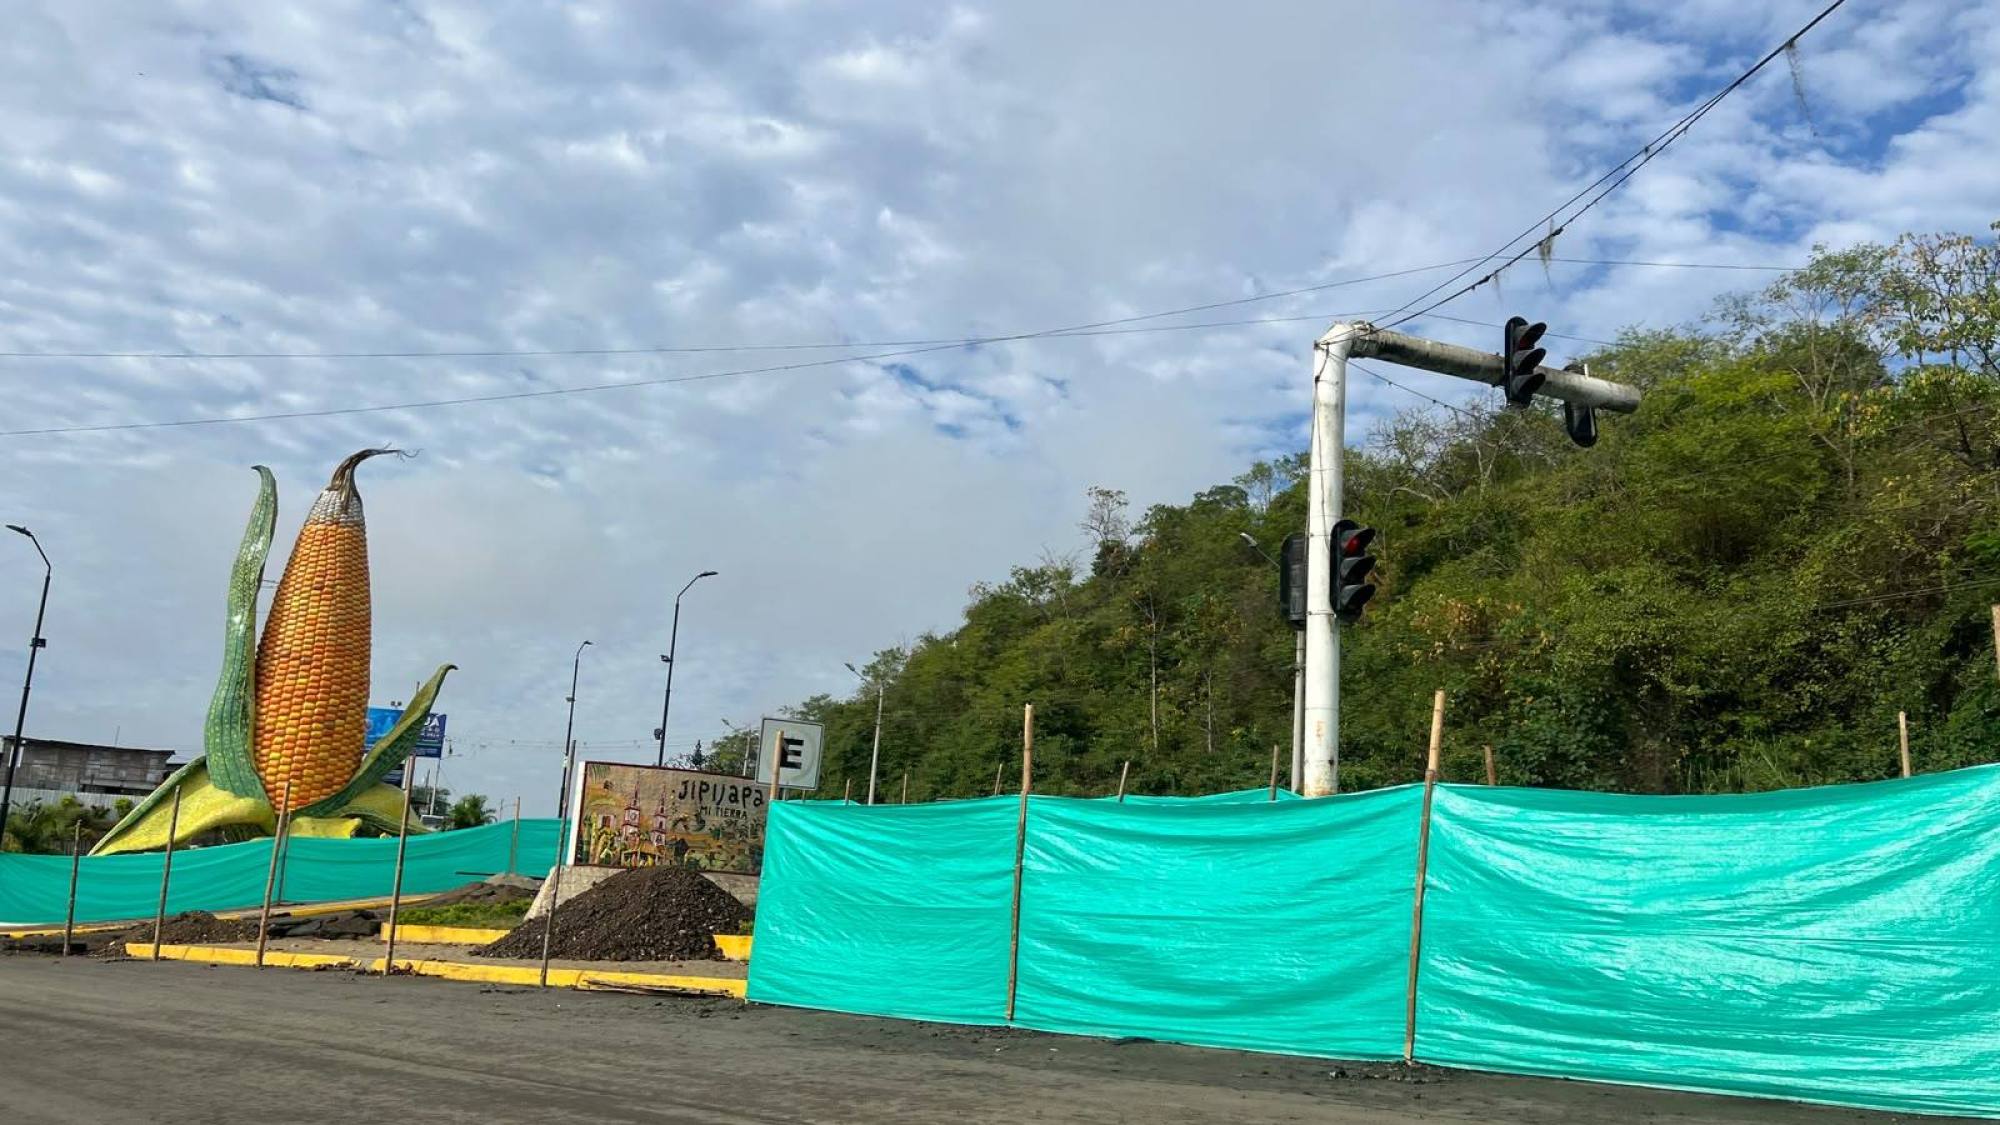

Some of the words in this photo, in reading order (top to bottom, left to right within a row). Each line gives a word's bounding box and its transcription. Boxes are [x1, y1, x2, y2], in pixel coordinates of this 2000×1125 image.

[779, 738, 804, 770] E
[701, 807, 711, 816] MI
[716, 807, 748, 820] TIERRA
